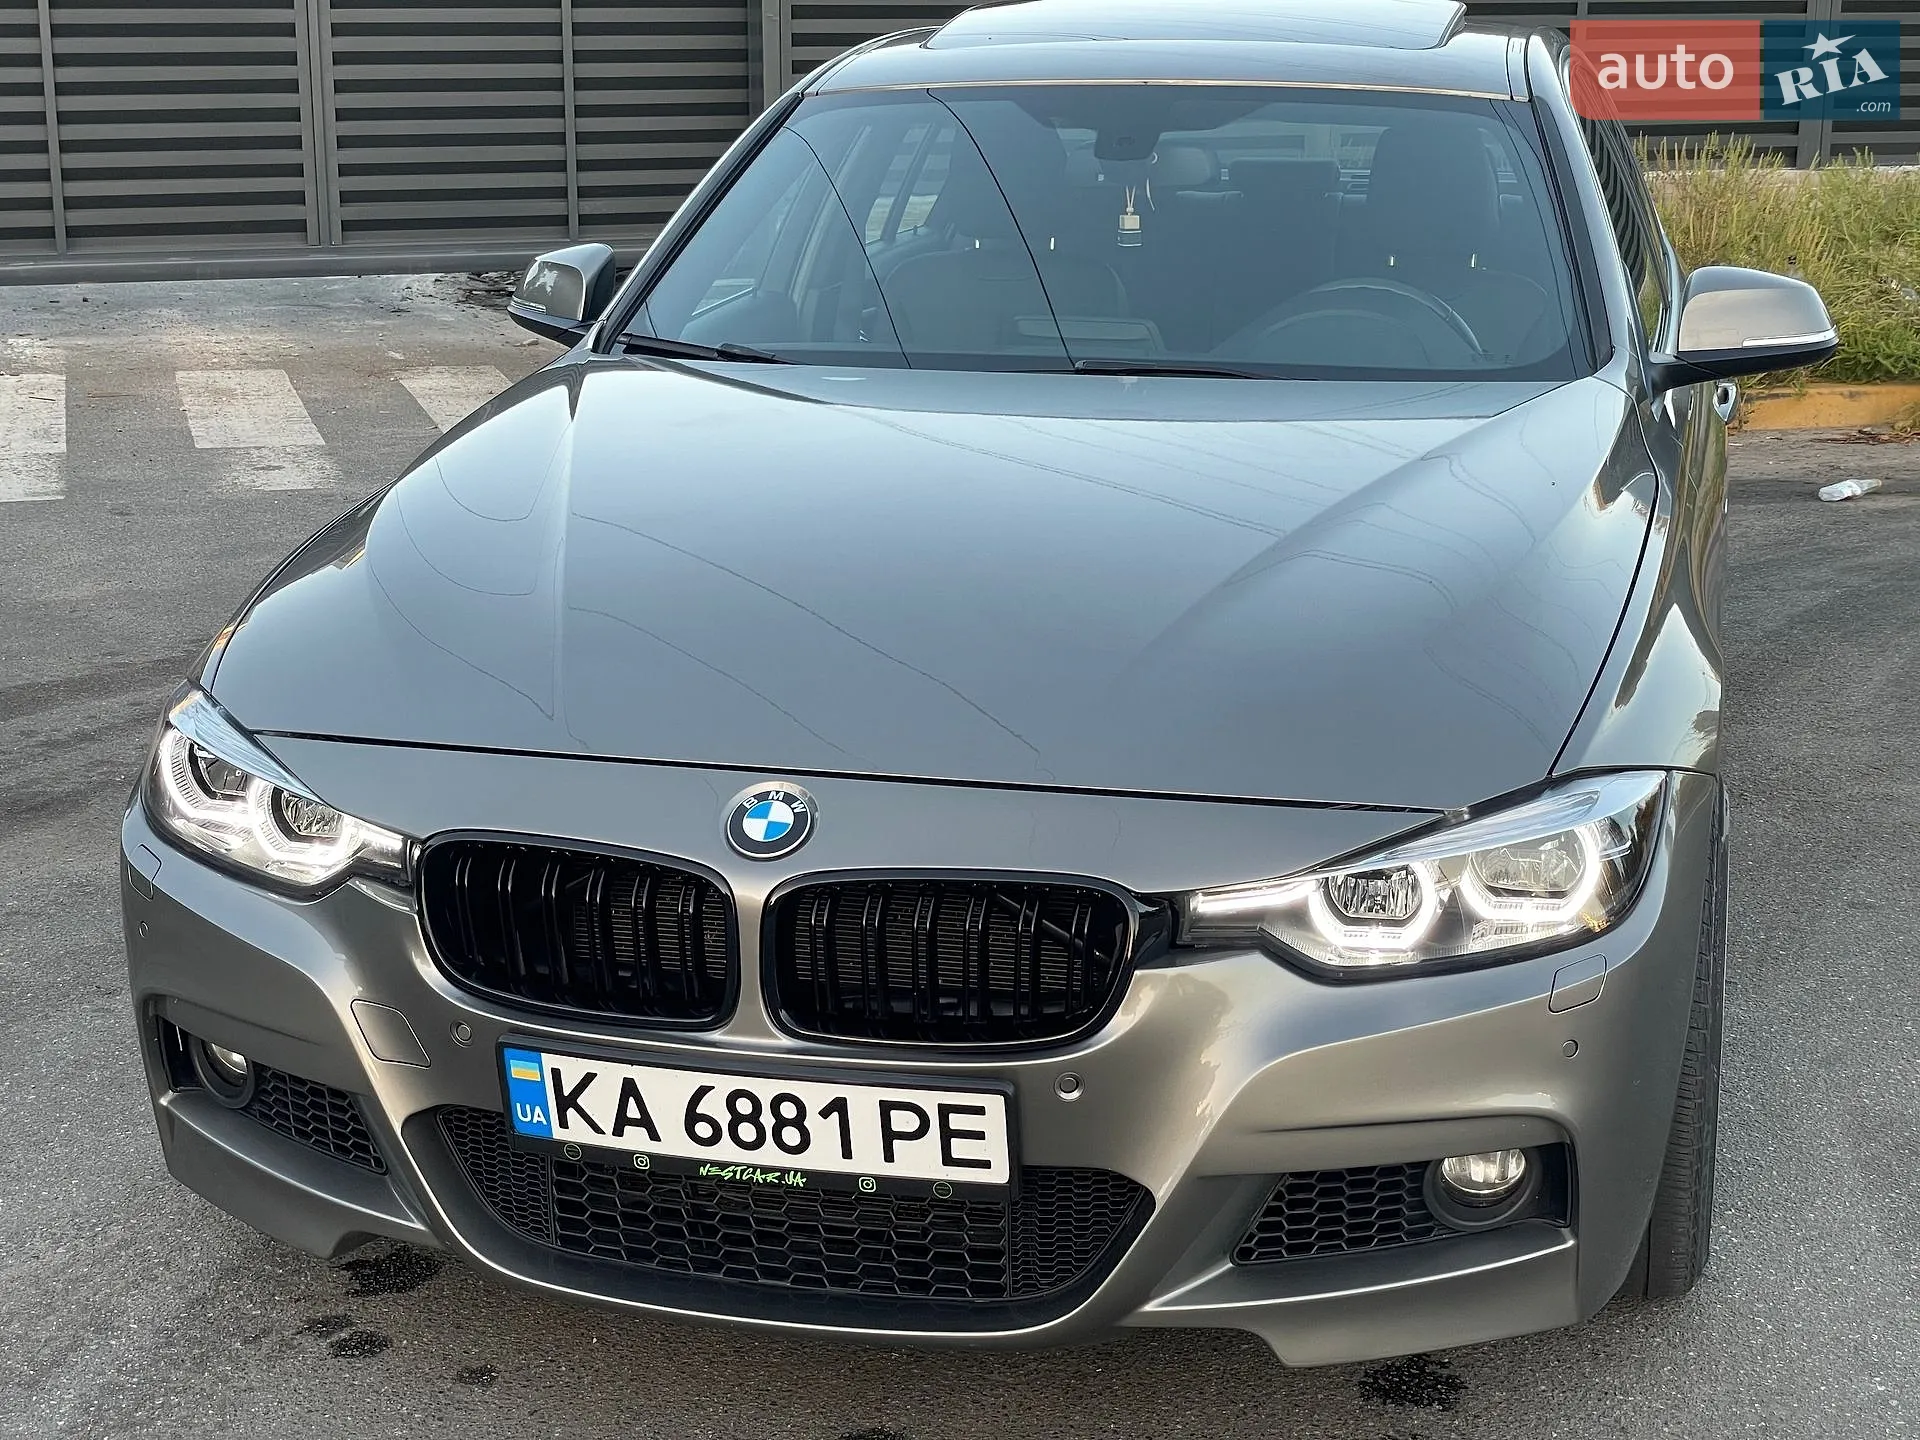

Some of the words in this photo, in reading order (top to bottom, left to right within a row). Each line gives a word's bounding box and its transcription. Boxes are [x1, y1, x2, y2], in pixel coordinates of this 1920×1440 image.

[743, 790, 806, 813] BMW
[516, 1103, 547, 1125] UA
[551, 1067, 661, 1142] KA
[684, 1085, 853, 1160] 6881
[879, 1100, 991, 1169] PE
